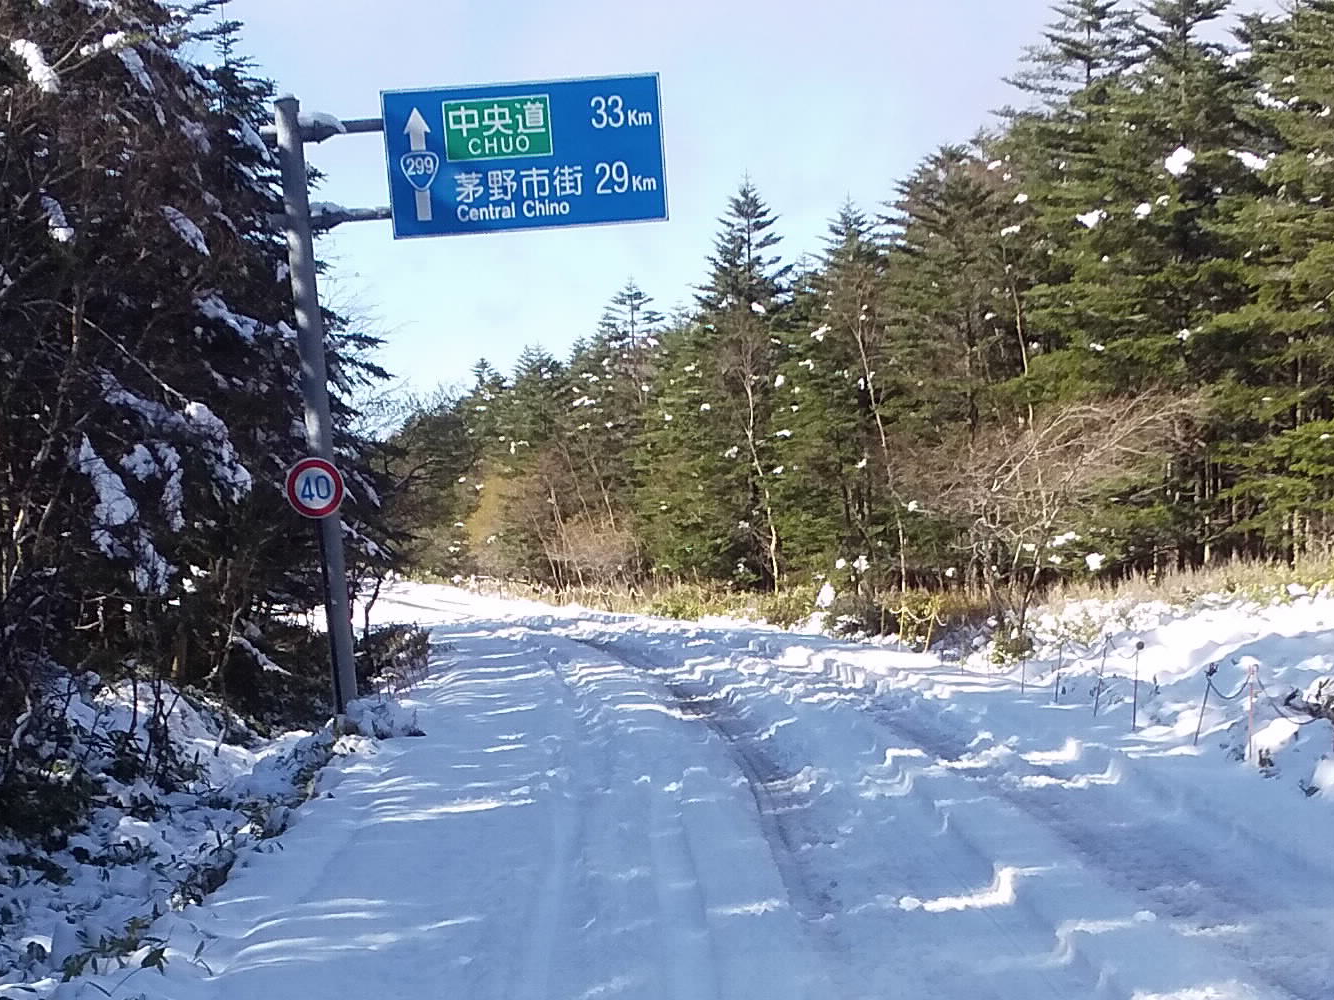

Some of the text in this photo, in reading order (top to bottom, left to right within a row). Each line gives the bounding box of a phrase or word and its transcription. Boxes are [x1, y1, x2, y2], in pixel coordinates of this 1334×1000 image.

[448, 101, 546, 137] 中央道
[591, 95, 652, 128] 33 Km
[468, 135, 529, 155] CHUO
[406, 156, 434, 175] 299
[595, 161, 657, 194] 29 Km
[454, 165, 583, 203] 茅野市街
[457, 199, 570, 222] Central Chino
[301, 475, 331, 500] 40
